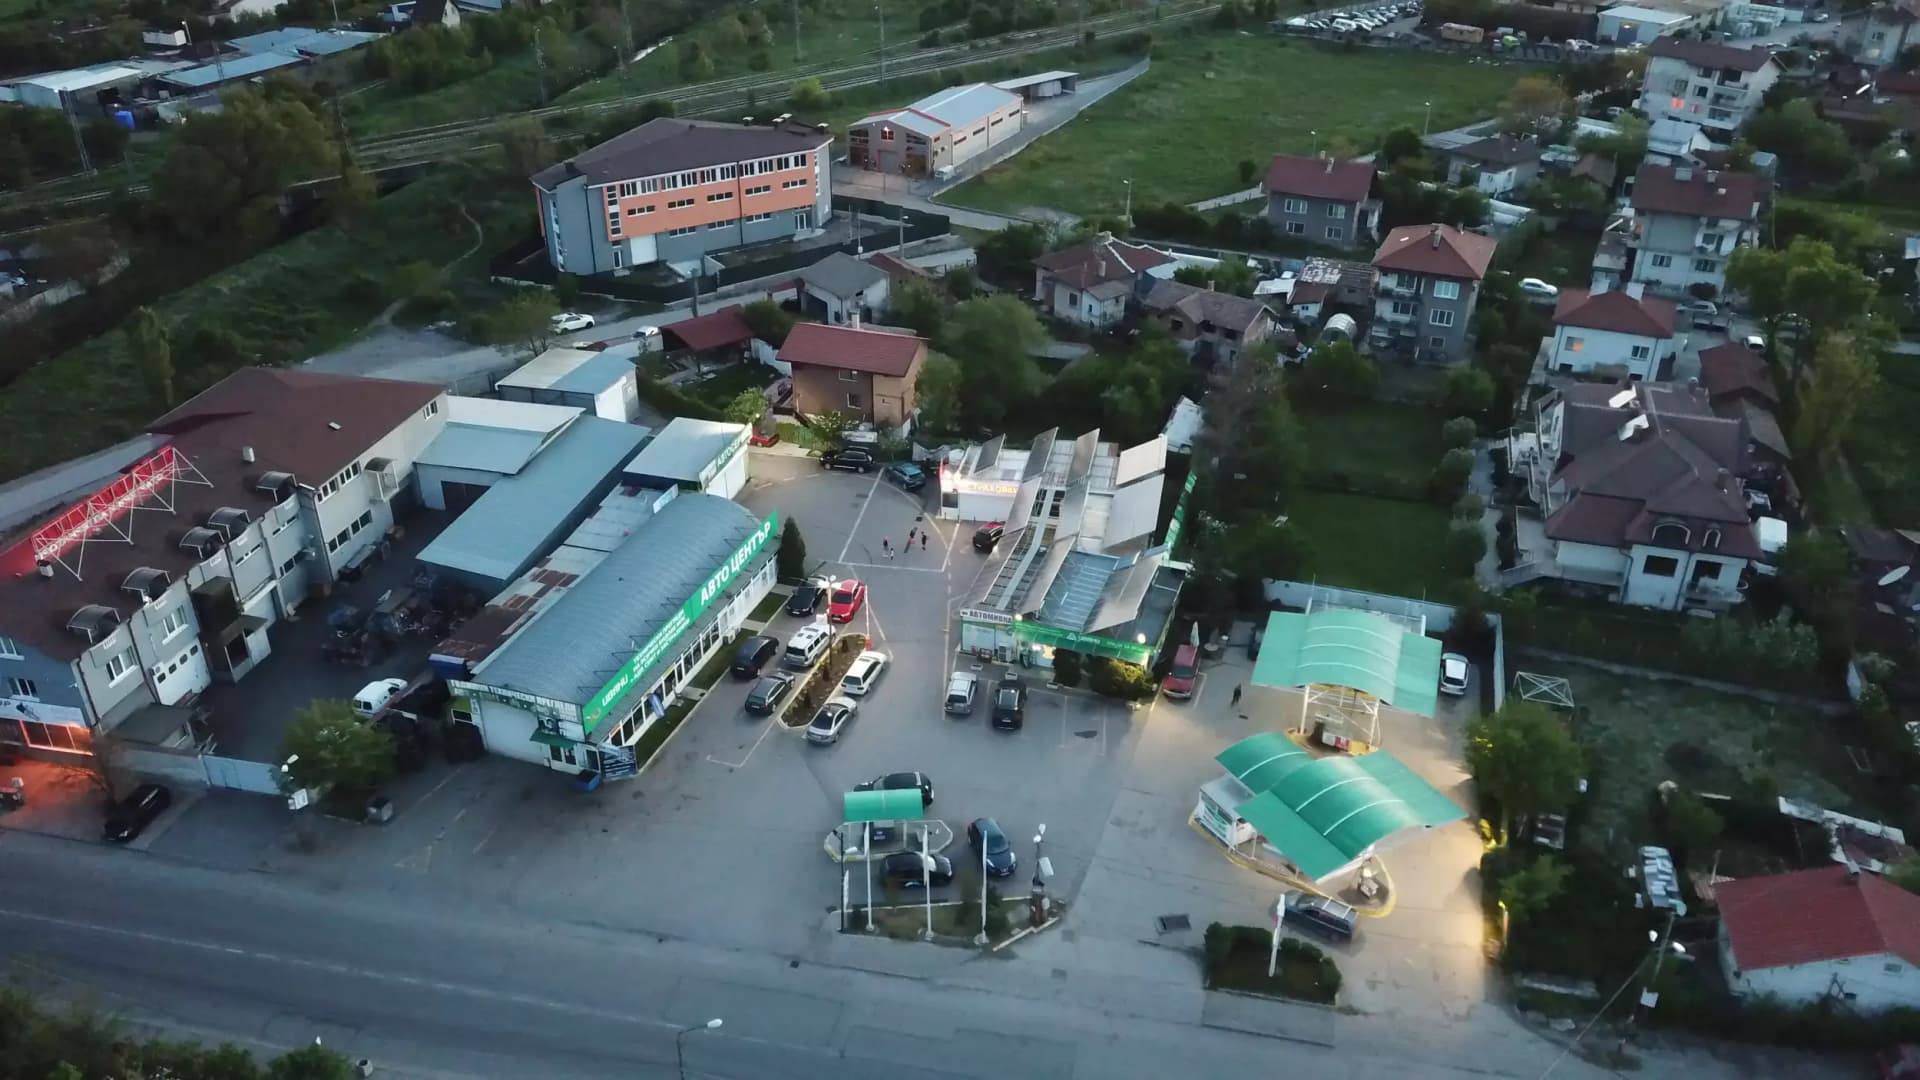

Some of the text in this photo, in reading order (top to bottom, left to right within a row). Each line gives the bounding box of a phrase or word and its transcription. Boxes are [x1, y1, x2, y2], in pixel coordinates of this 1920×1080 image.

[701, 520, 771, 605] АВТО ЦЕНТЪР
[969, 611, 1012, 624] АВТОМИВКА
